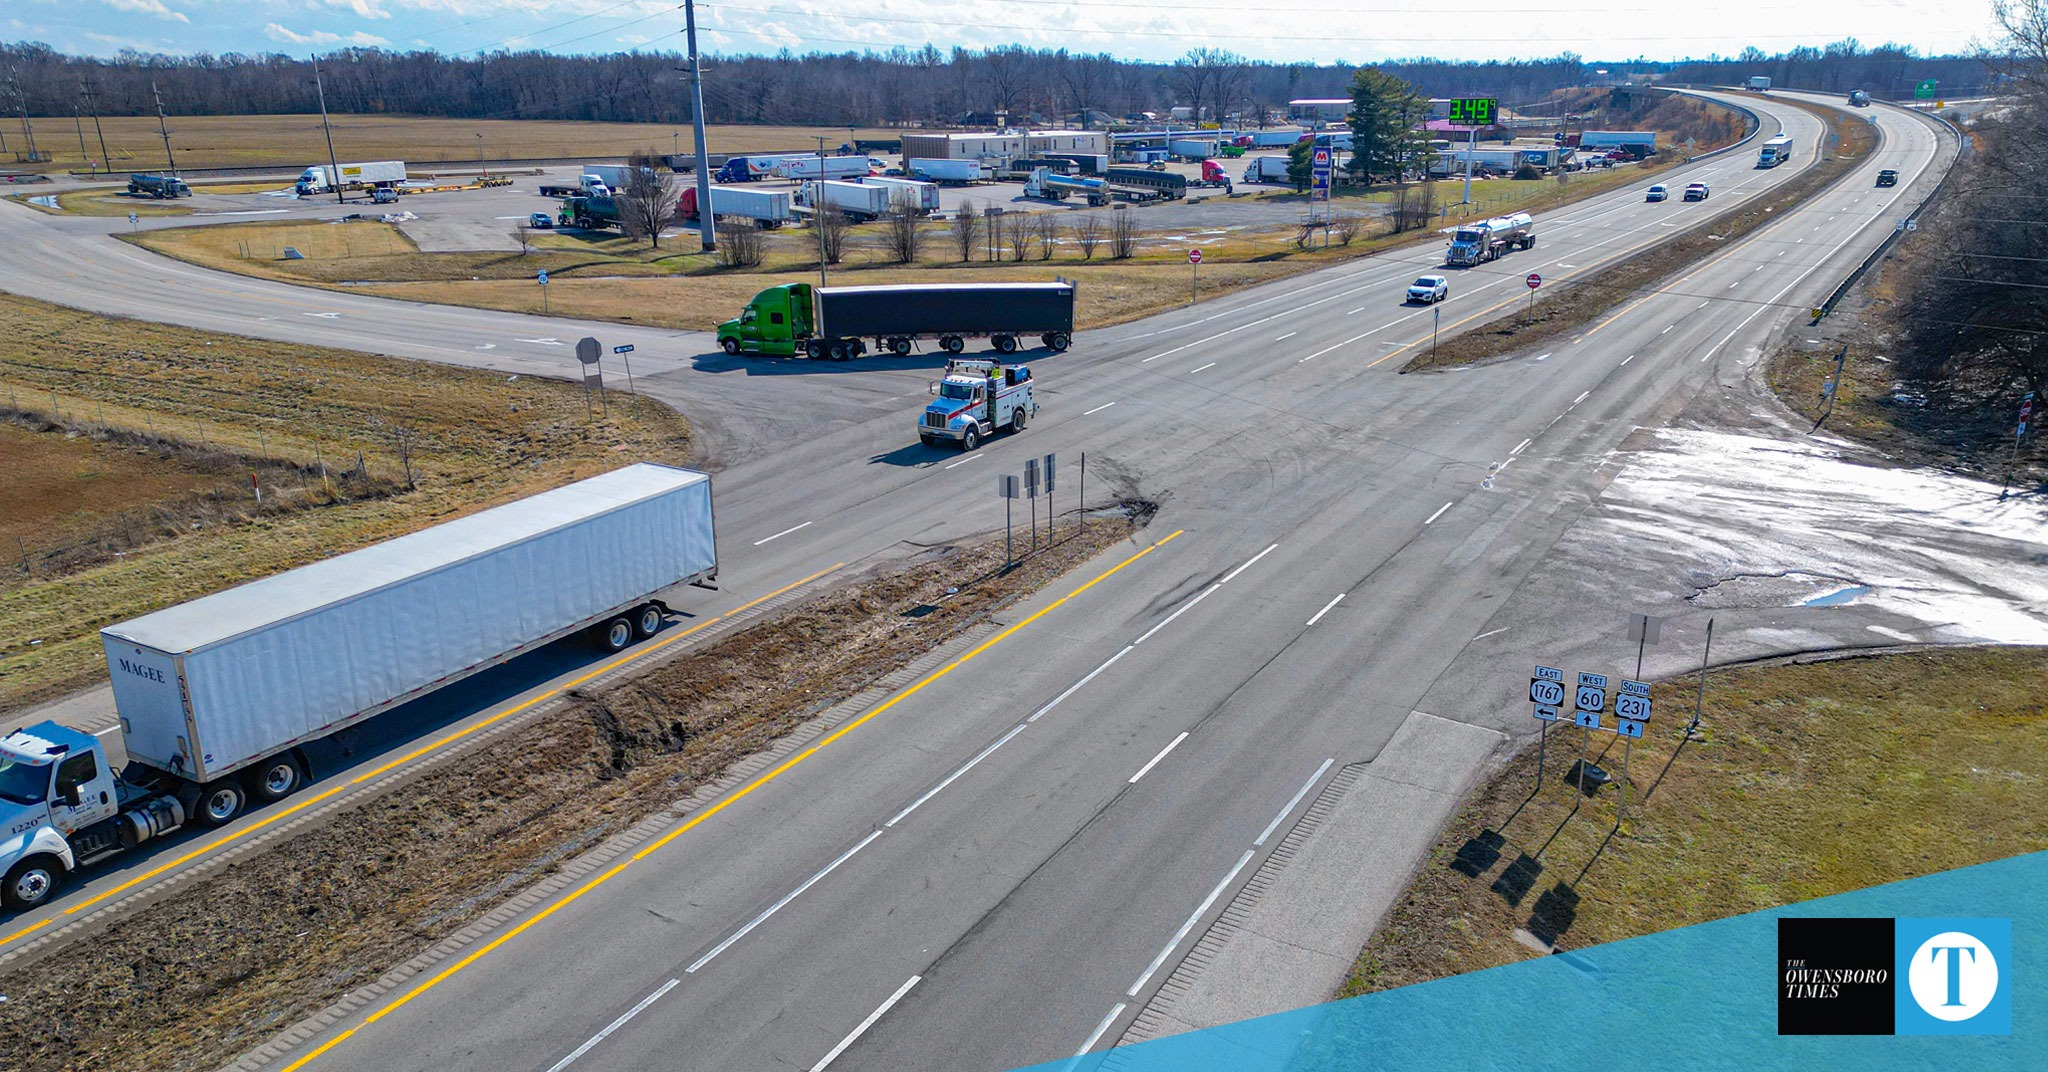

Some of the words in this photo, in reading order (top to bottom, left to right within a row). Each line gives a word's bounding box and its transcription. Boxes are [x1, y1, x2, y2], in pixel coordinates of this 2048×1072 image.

[119, 658, 165, 684] MAGEE
[1539, 668, 1558, 679] EAST
[1582, 675, 1603, 685] WEST
[1534, 684, 1560, 700] 1767
[1623, 682, 1649, 694] SOUTH
[1580, 692, 1601, 707] 60
[1621, 699, 1645, 716] 231
[11, 819, 38, 835] 1220
